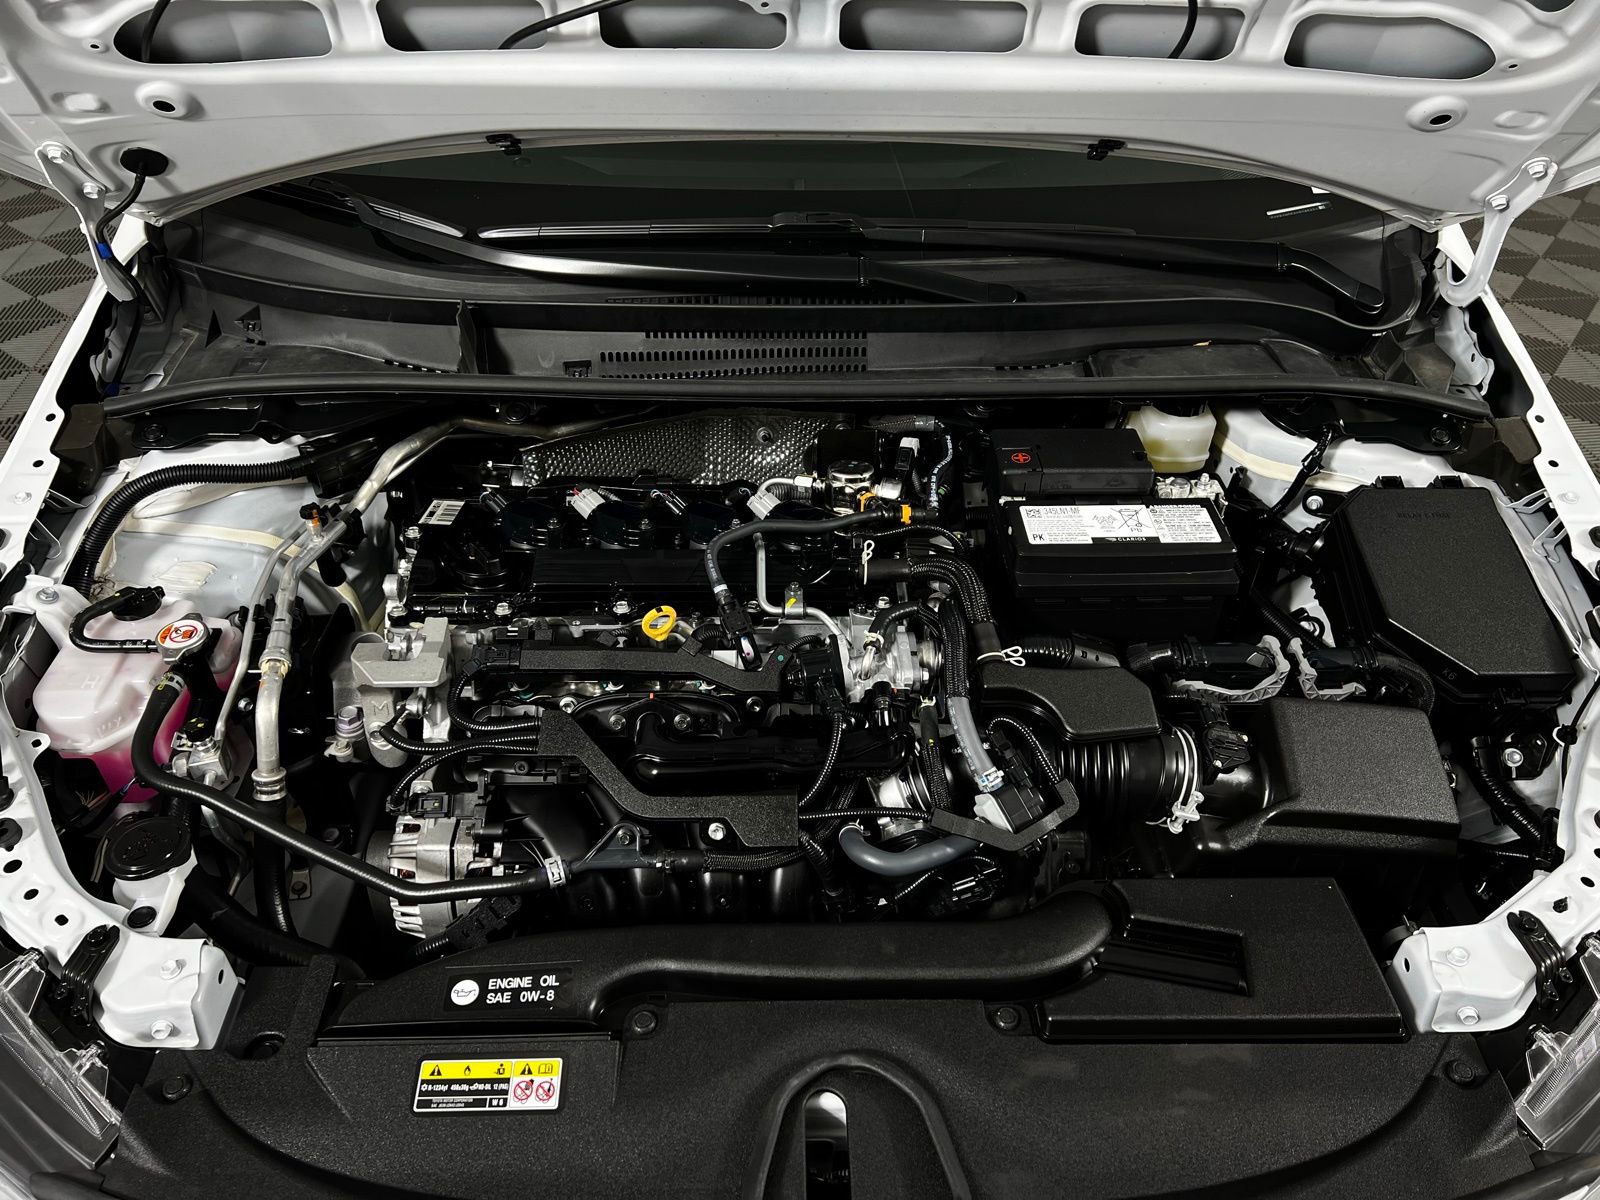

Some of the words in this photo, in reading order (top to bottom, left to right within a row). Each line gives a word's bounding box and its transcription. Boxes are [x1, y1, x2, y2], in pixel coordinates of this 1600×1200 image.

[488, 976, 533, 990] ENGINE
[539, 974, 560, 987] OIL
[486, 992, 512, 1004] SAE
[519, 990, 555, 1002] 0W-8
